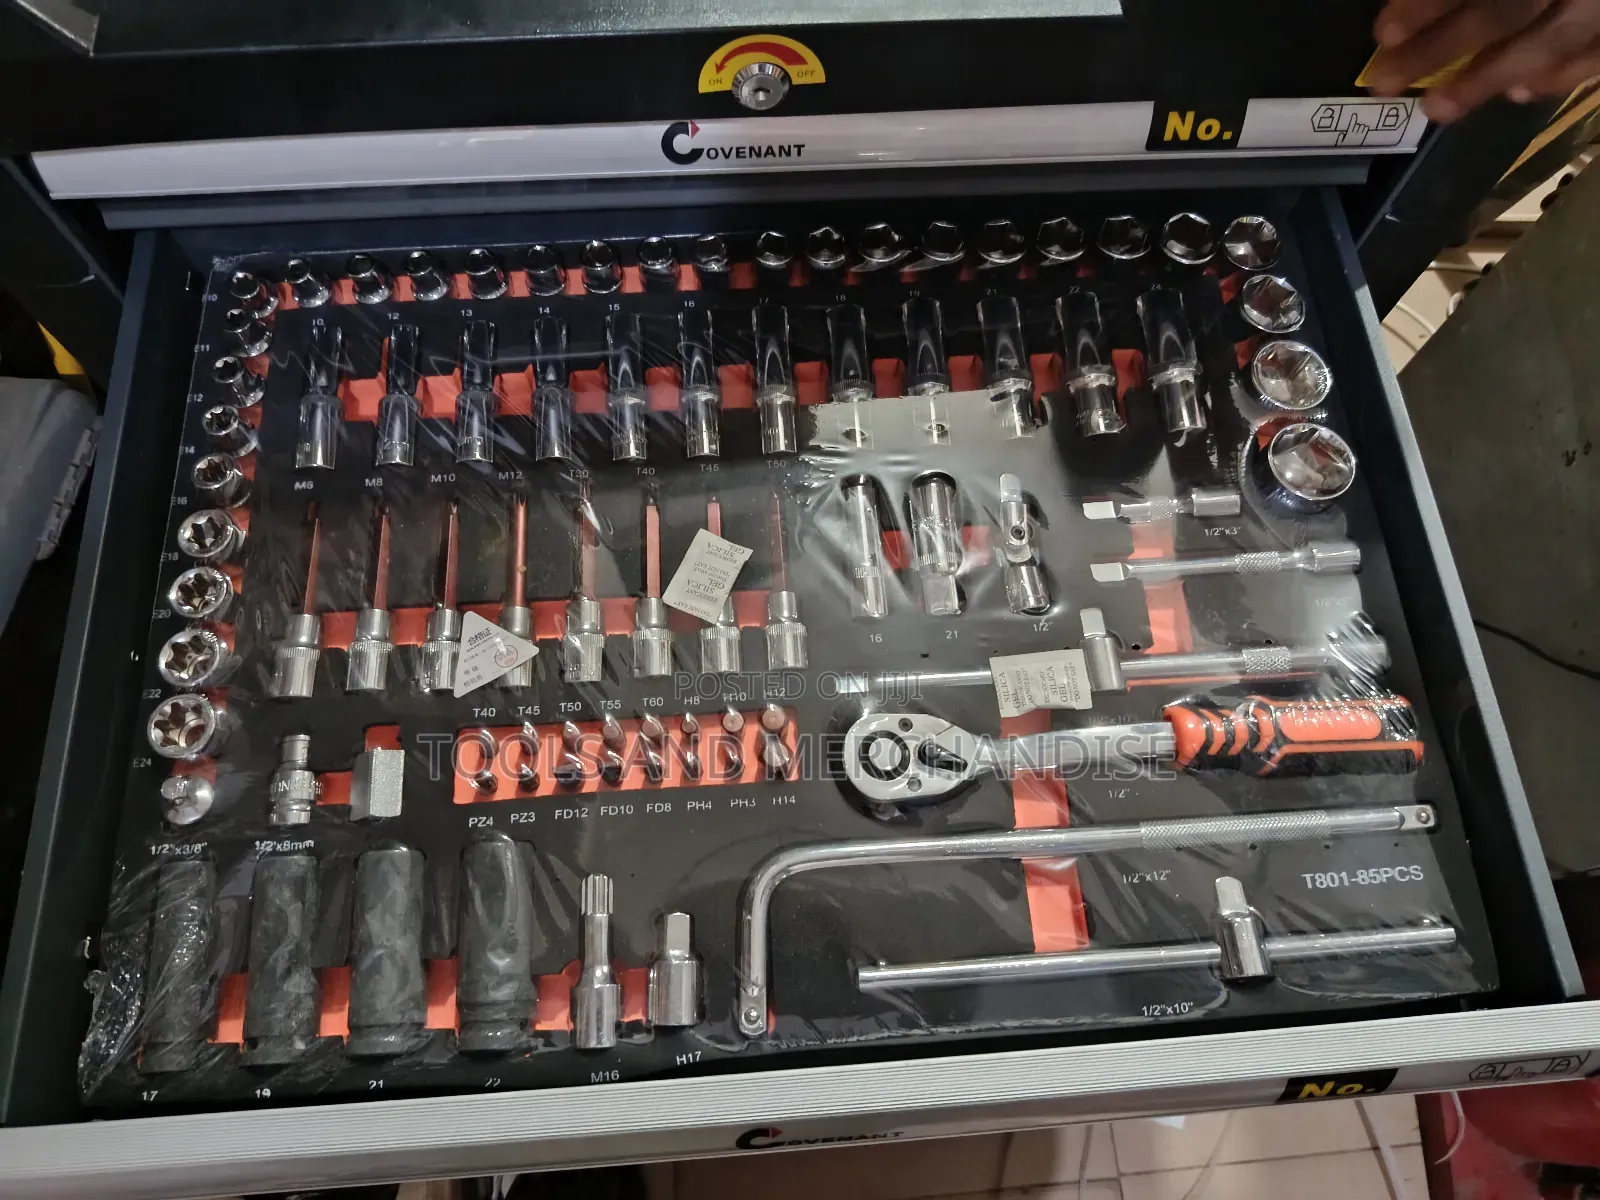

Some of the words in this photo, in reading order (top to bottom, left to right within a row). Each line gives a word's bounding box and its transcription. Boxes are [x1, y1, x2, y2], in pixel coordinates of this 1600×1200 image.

[796, 69, 817, 79] OFF
[708, 77, 723, 86] ON
[1163, 110, 1233, 142] No.
[661, 120, 806, 166] COVENANT
[608, 303, 621, 312] 15
[683, 300, 696, 308] 16
[387, 311, 400, 320] 12
[460, 309, 473, 317] 13
[538, 306, 551, 315] 14
[700, 463, 720, 472] T45
[766, 459, 787, 469] T50
[498, 470, 523, 481] M12
[569, 468, 589, 478] T30
[636, 466, 655, 476] T40
[365, 477, 383, 487] M8
[431, 473, 456, 483] M10
[1204, 526, 1242, 537] 1/2"x3"
[707, 542, 736, 558] SILICA
[729, 544, 745, 555] GEL
[687, 579, 716, 594] SILICA
[708, 577, 726, 590] GEL
[870, 634, 883, 643] 16
[946, 630, 958, 639] 21
[1046, 665, 1059, 696] SILICA
[998, 671, 1010, 703] SILICA
[142, 688, 162, 699] E22
[1011, 688, 1020, 709] GEL
[1059, 683, 1068, 703] GEL
[599, 698, 622, 710] T55
[642, 696, 664, 707] T60
[684, 694, 700, 705] H8
[472, 707, 496, 718] T40
[517, 705, 541, 716] T45
[559, 701, 582, 713] T50
[133, 758, 152, 768] E24
[686, 799, 712, 811] PH4
[730, 797, 756, 808] PH3
[772, 794, 796, 805] H14
[600, 803, 634, 816] FD10
[646, 801, 672, 813] FD8
[510, 811, 536, 823] PZ3
[554, 807, 589, 820] FD12
[468, 816, 494, 828] PZ4
[1300, 865, 1424, 890] T801-85PCS
[1141, 1001, 1194, 1017] 1/2"x10"
[676, 1051, 702, 1066] H17
[590, 1069, 620, 1083] M16
[368, 1079, 384, 1089] 21
[1297, 1080, 1377, 1099] No.
[141, 1090, 159, 1102] 17
[255, 1088, 272, 1099] 19
